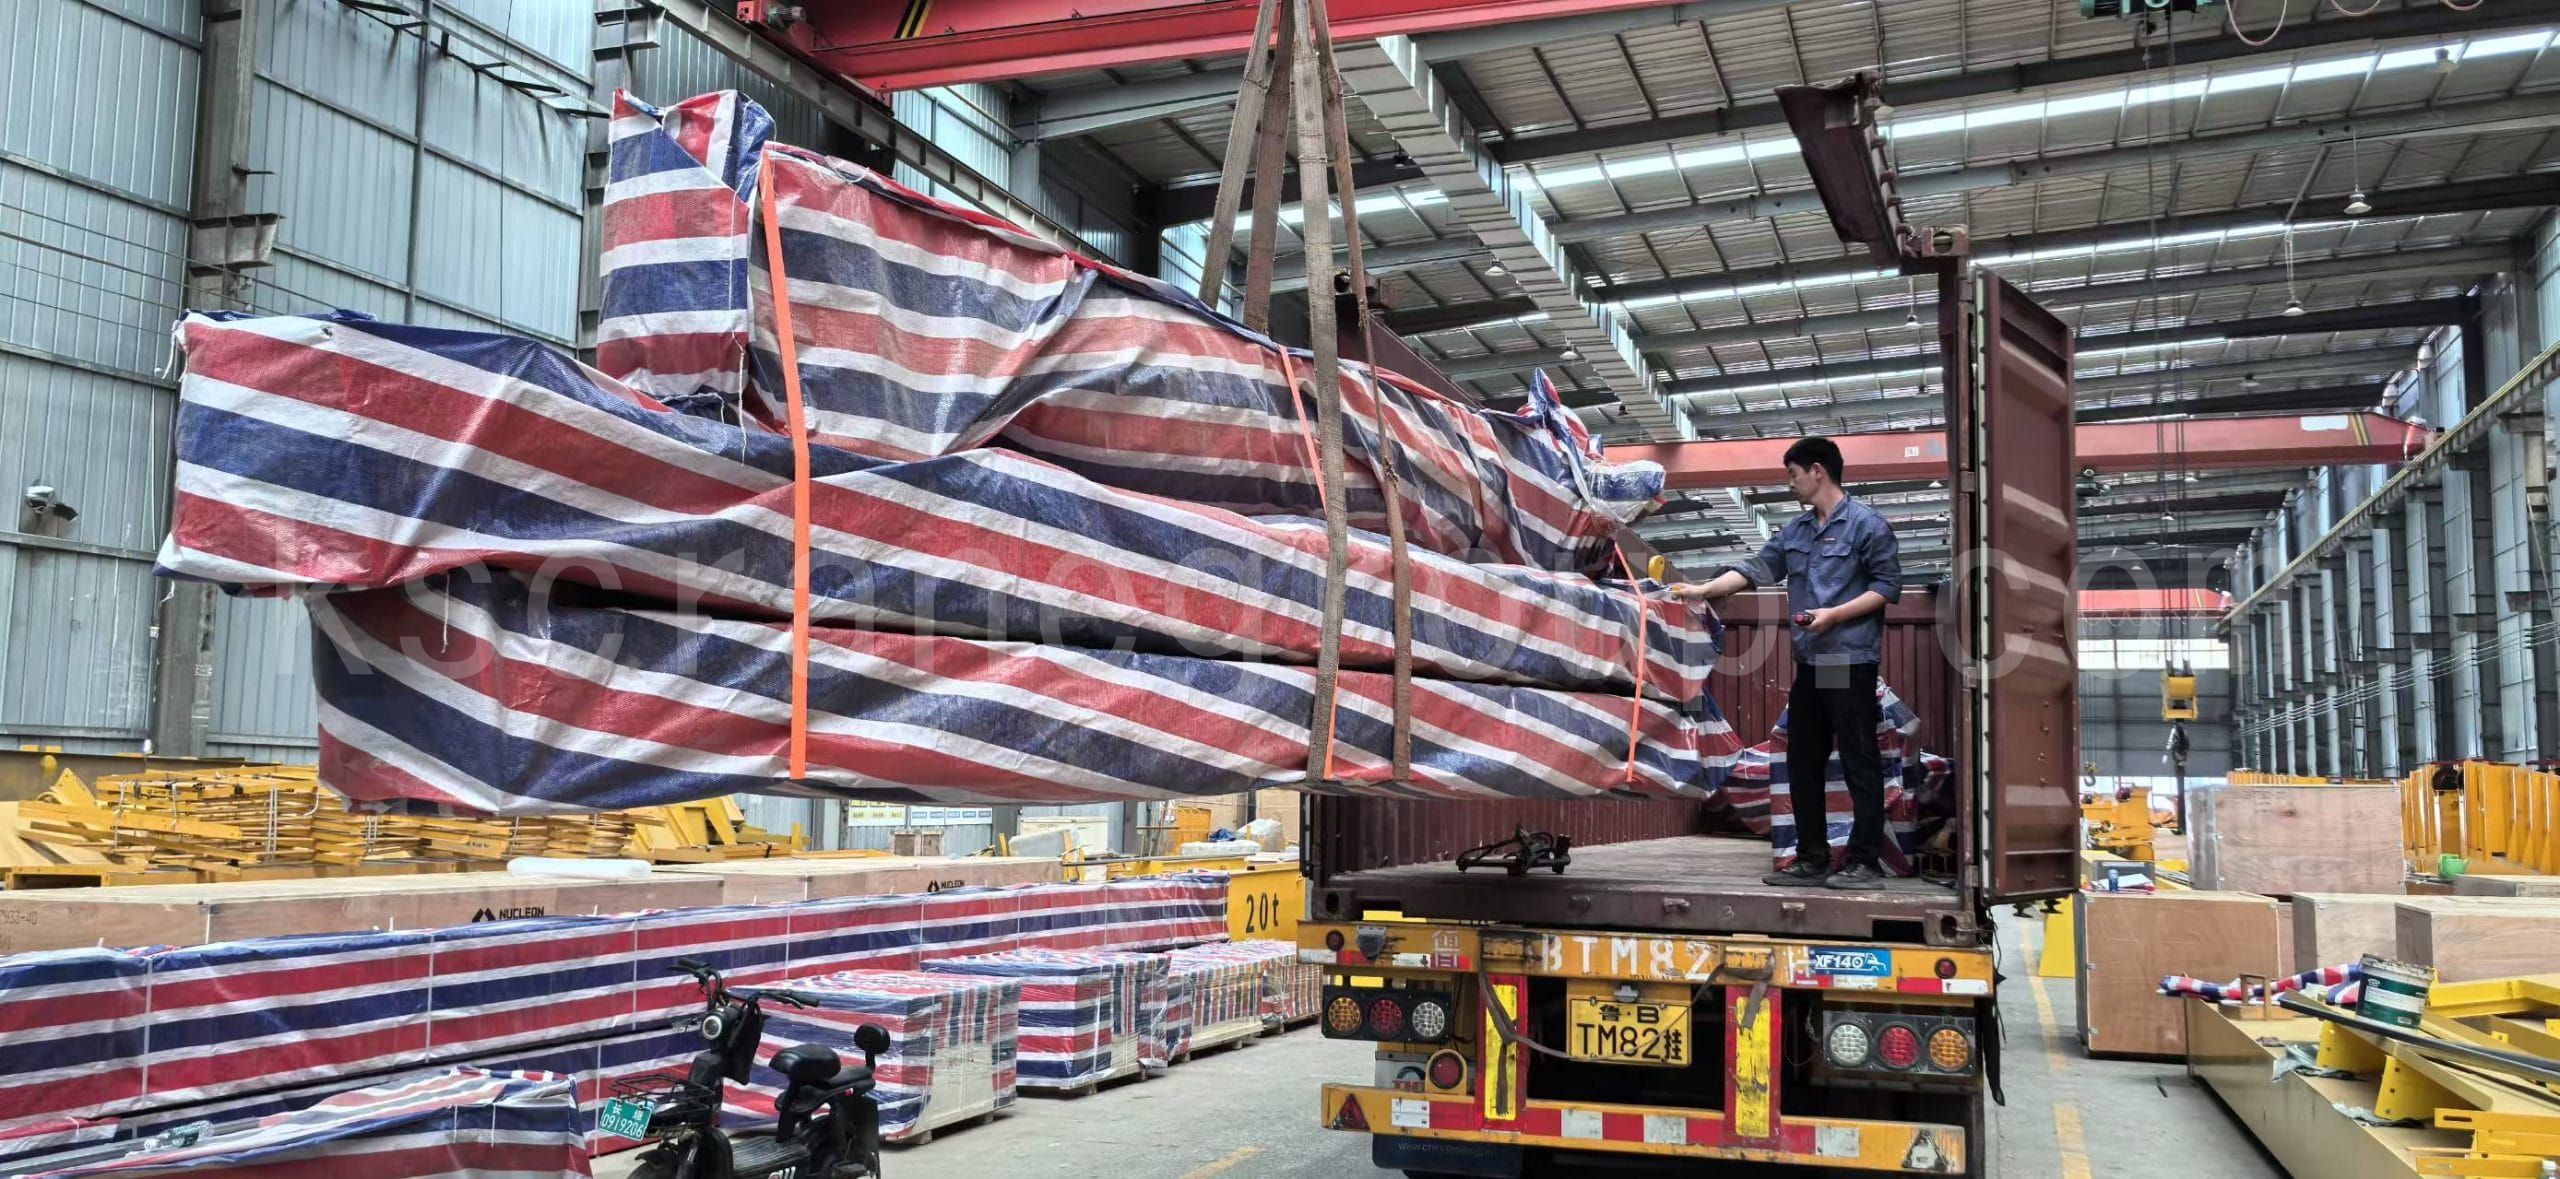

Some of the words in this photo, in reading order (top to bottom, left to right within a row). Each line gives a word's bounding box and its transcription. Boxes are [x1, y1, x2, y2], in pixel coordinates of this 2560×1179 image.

[500, 906, 545, 920] NUCLEON
[1246, 892, 1279, 933] 20t
[1542, 933, 1713, 980] BTM82
[601, 1113, 645, 1138] 0919206
